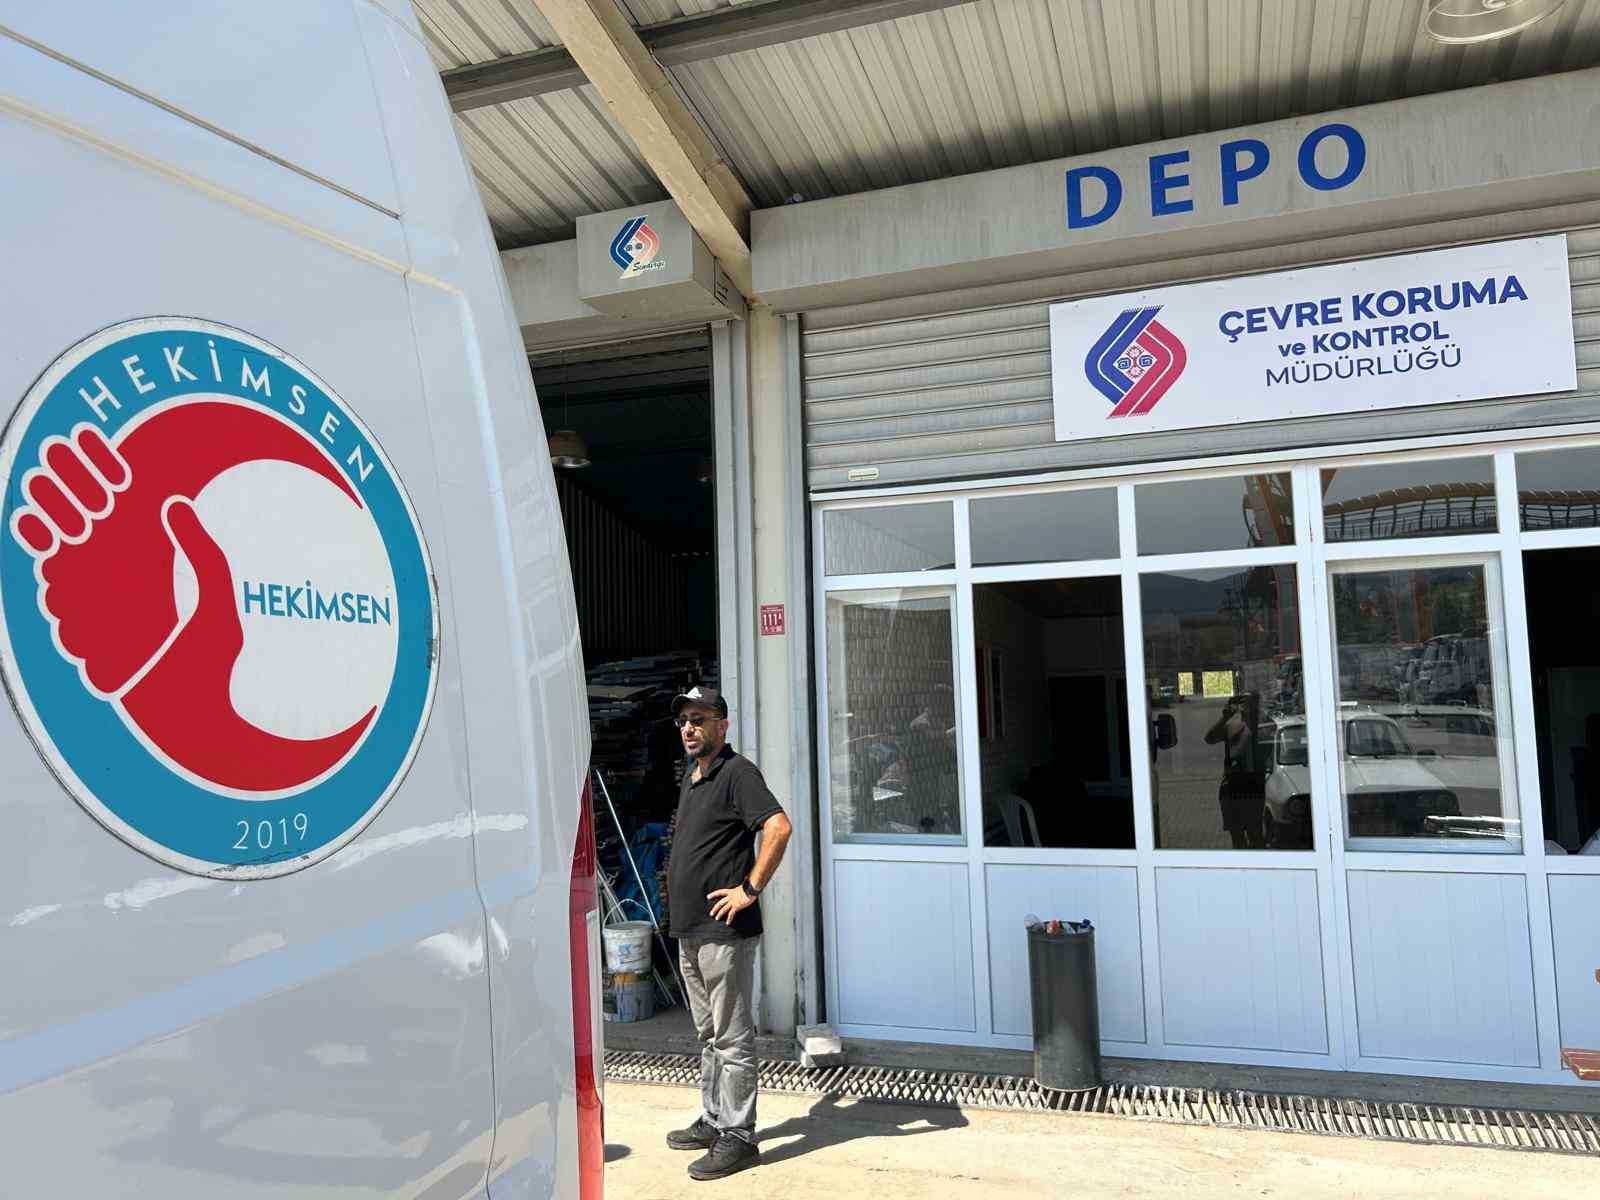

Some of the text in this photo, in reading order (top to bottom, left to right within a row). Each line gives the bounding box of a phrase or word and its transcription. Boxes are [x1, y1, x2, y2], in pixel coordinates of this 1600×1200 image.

[1065, 123, 1366, 230] DEPO
[1218, 274, 1528, 343] ÇEVRE KORUMA
[1278, 321, 1450, 358] ve KONTROL
[1265, 343, 1462, 387] MÜDÜRLÜĞÜ
[78, 340, 374, 483] HEKİMSEN
[242, 580, 391, 625] HEKİMSEN
[232, 813, 308, 850] 2019
